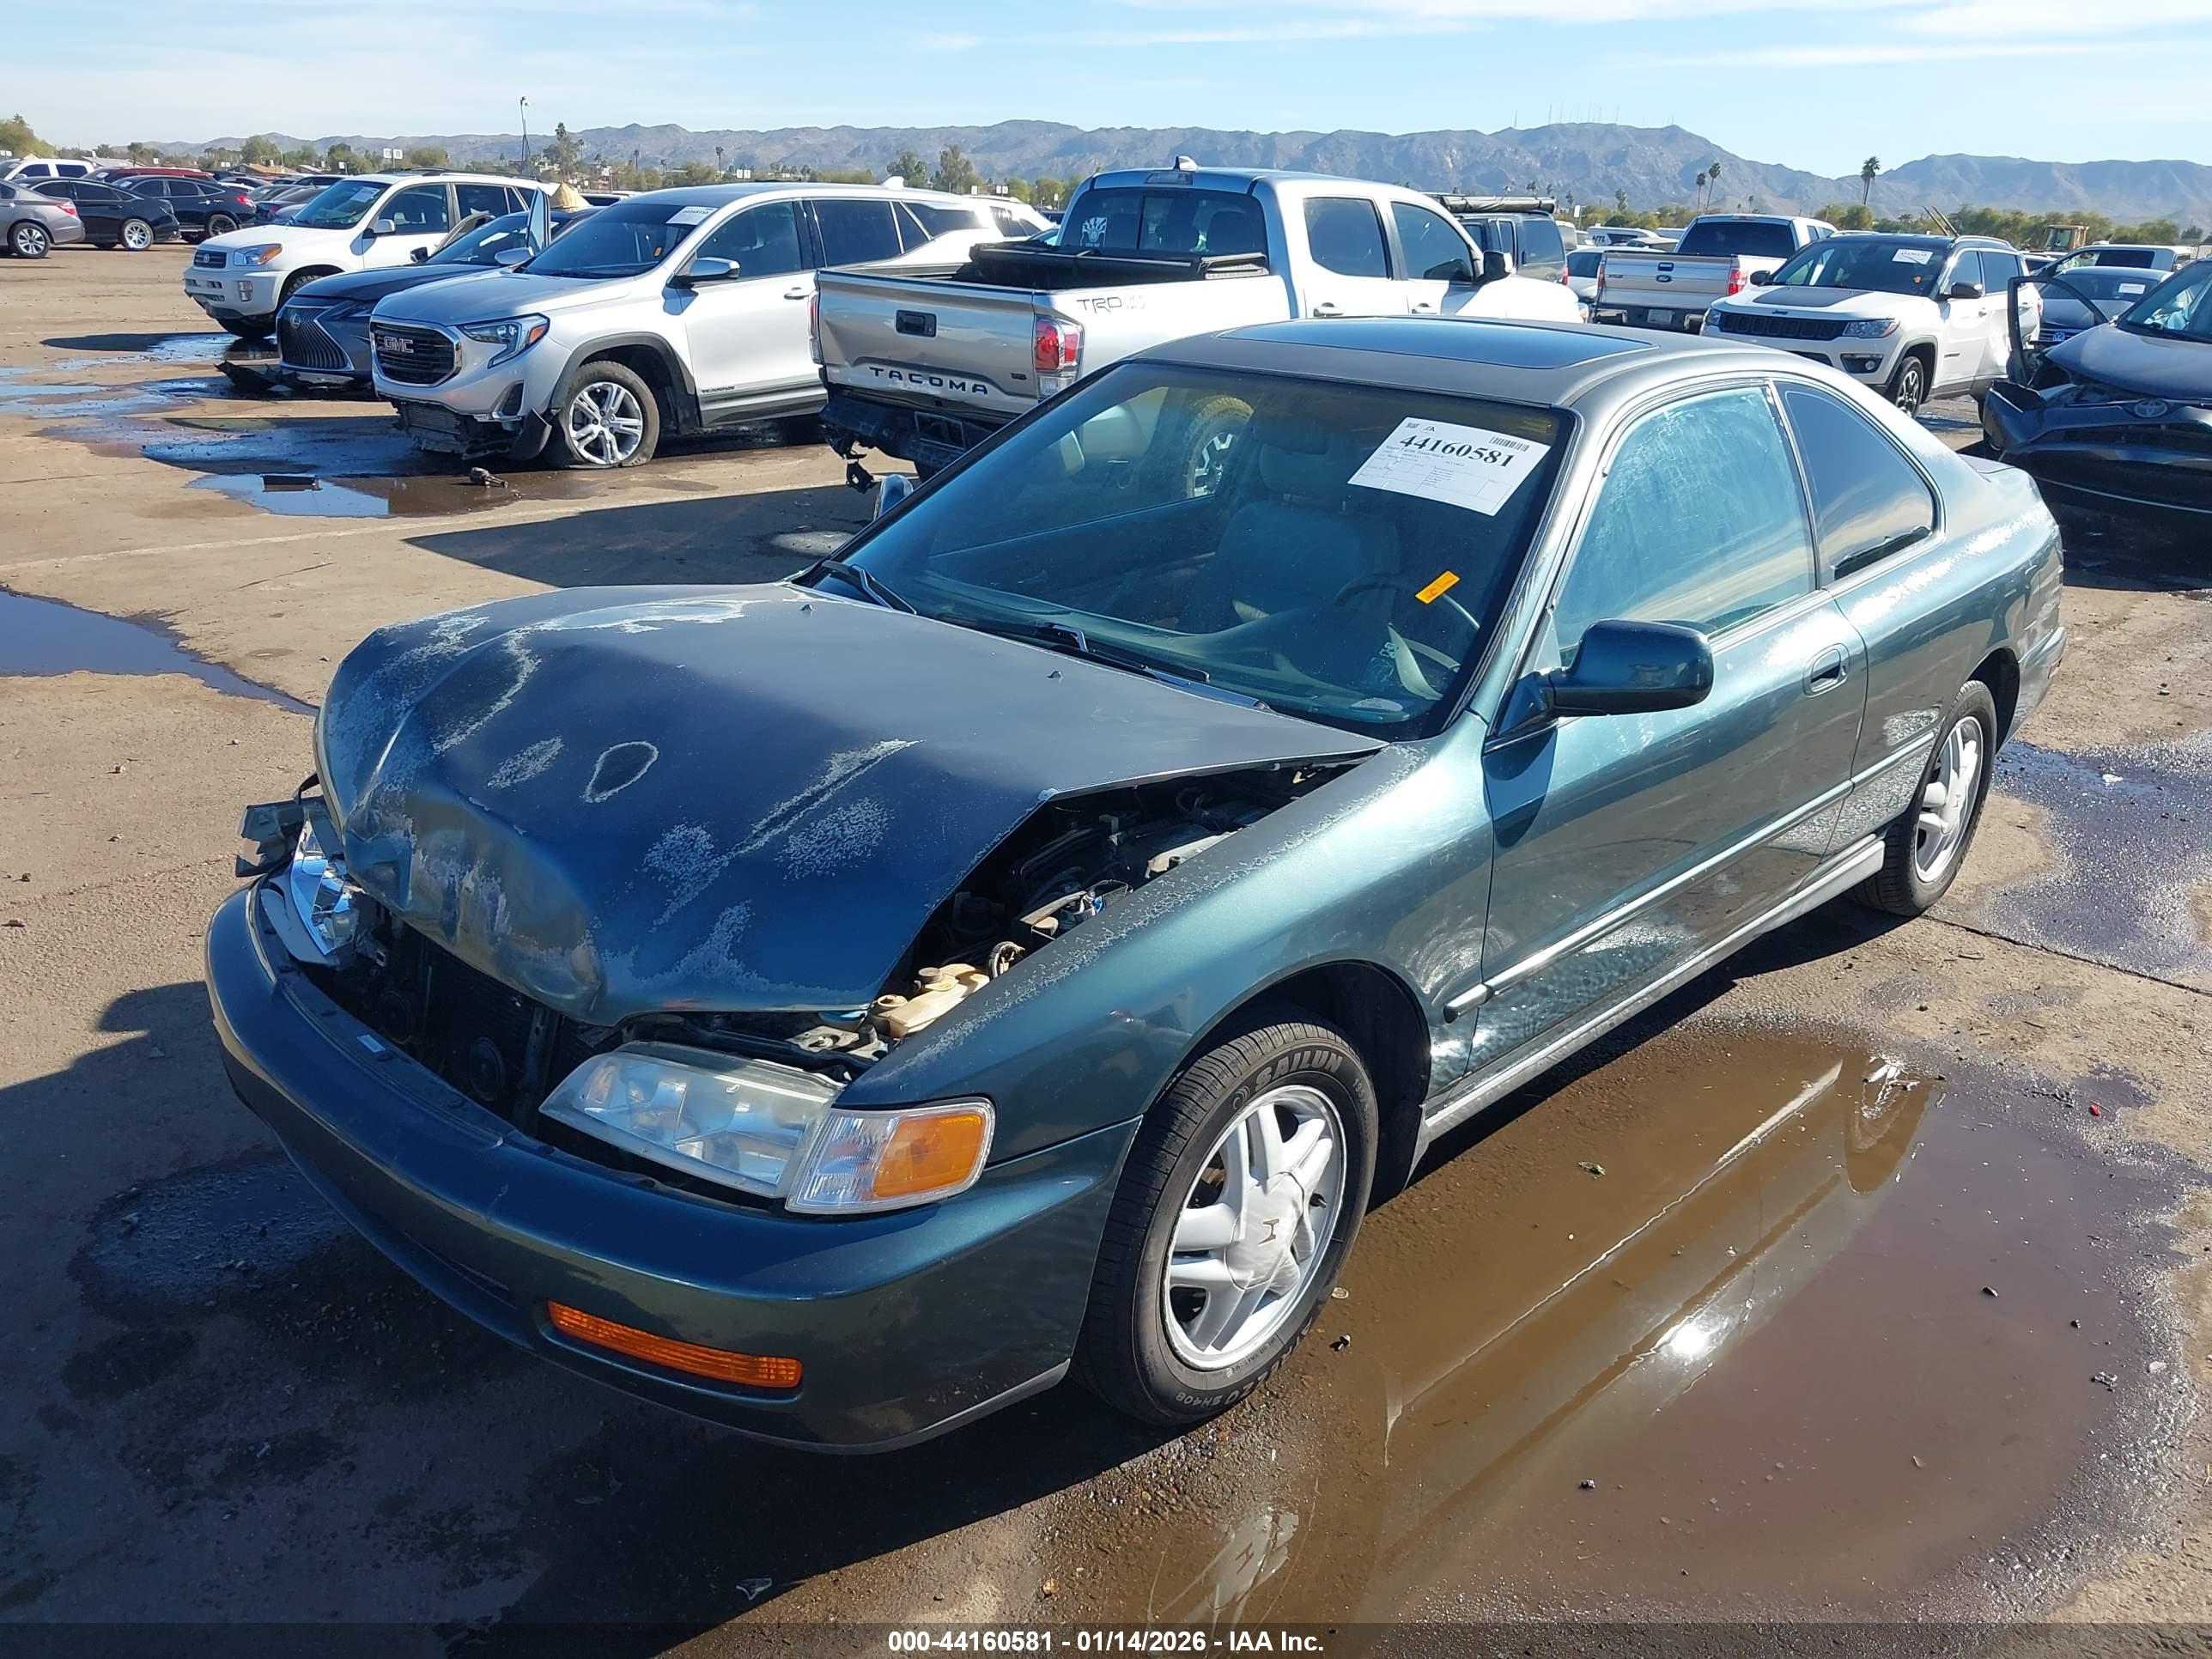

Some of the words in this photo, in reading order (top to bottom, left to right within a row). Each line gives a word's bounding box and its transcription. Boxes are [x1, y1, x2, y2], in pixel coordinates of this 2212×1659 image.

[1077, 296, 1121, 314] TRD
[384, 336, 414, 353] GMC
[869, 367, 988, 394] TACOMA
[1400, 434, 1514, 467] 44160581
[1255, 1050, 1343, 1091] SAILUN
